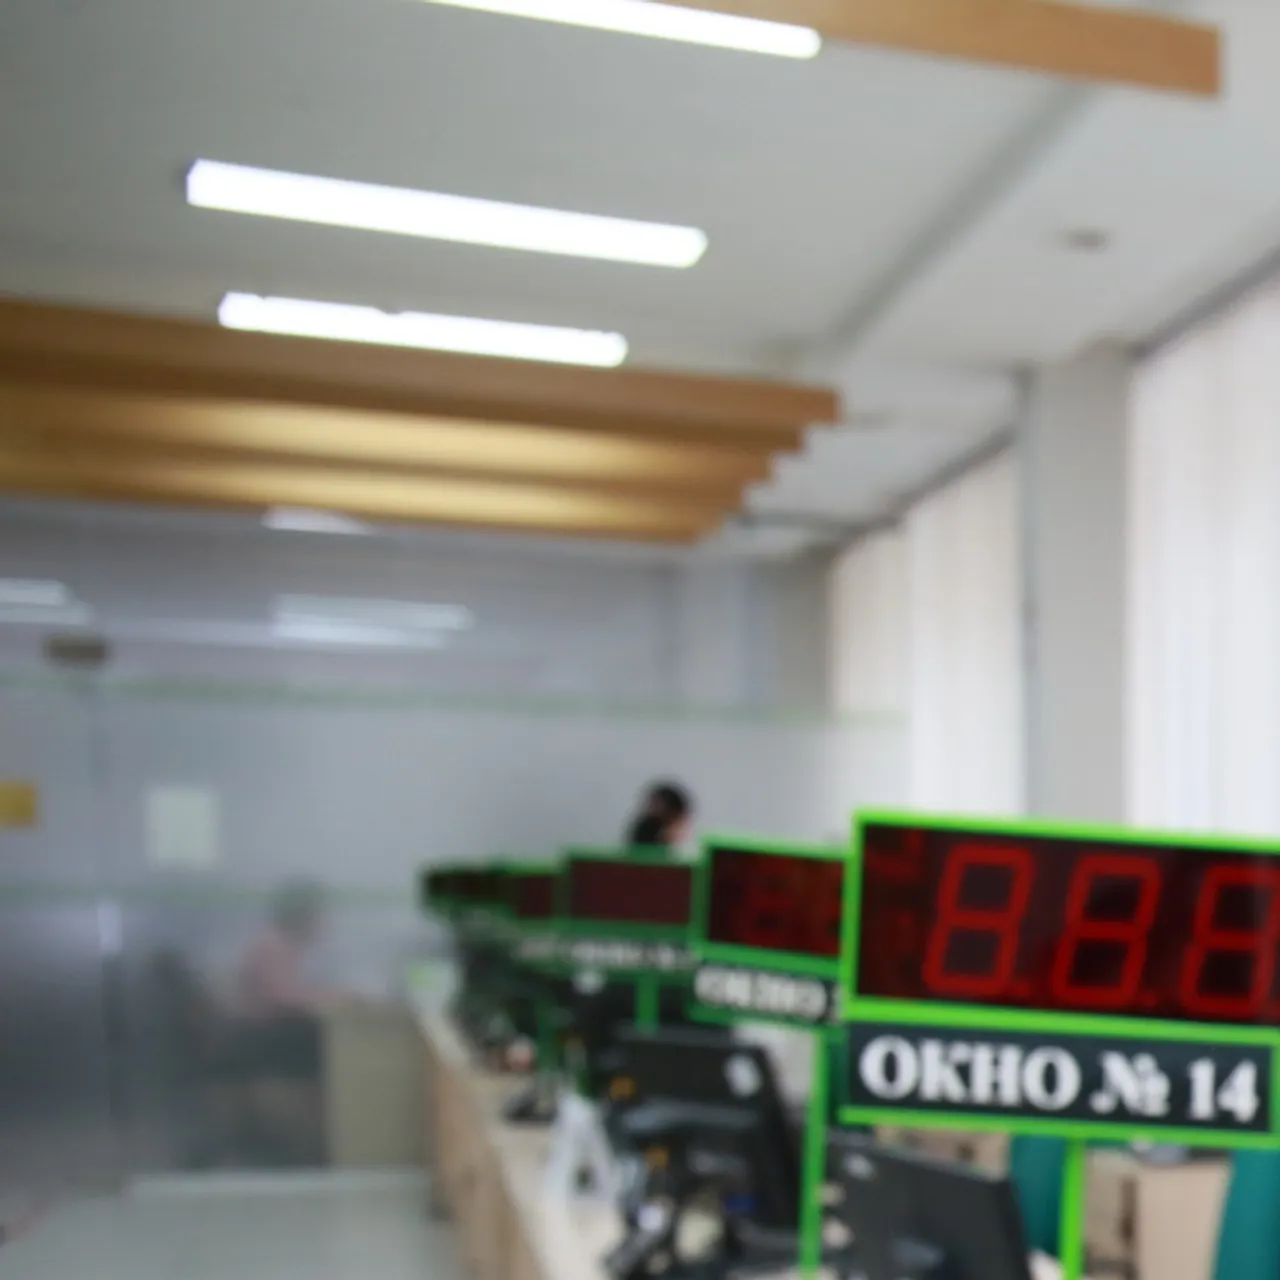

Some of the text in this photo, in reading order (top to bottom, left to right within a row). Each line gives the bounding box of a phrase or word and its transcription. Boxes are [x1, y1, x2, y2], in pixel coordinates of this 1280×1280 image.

[859, 1035, 1259, 1123] ОКНО № 14
